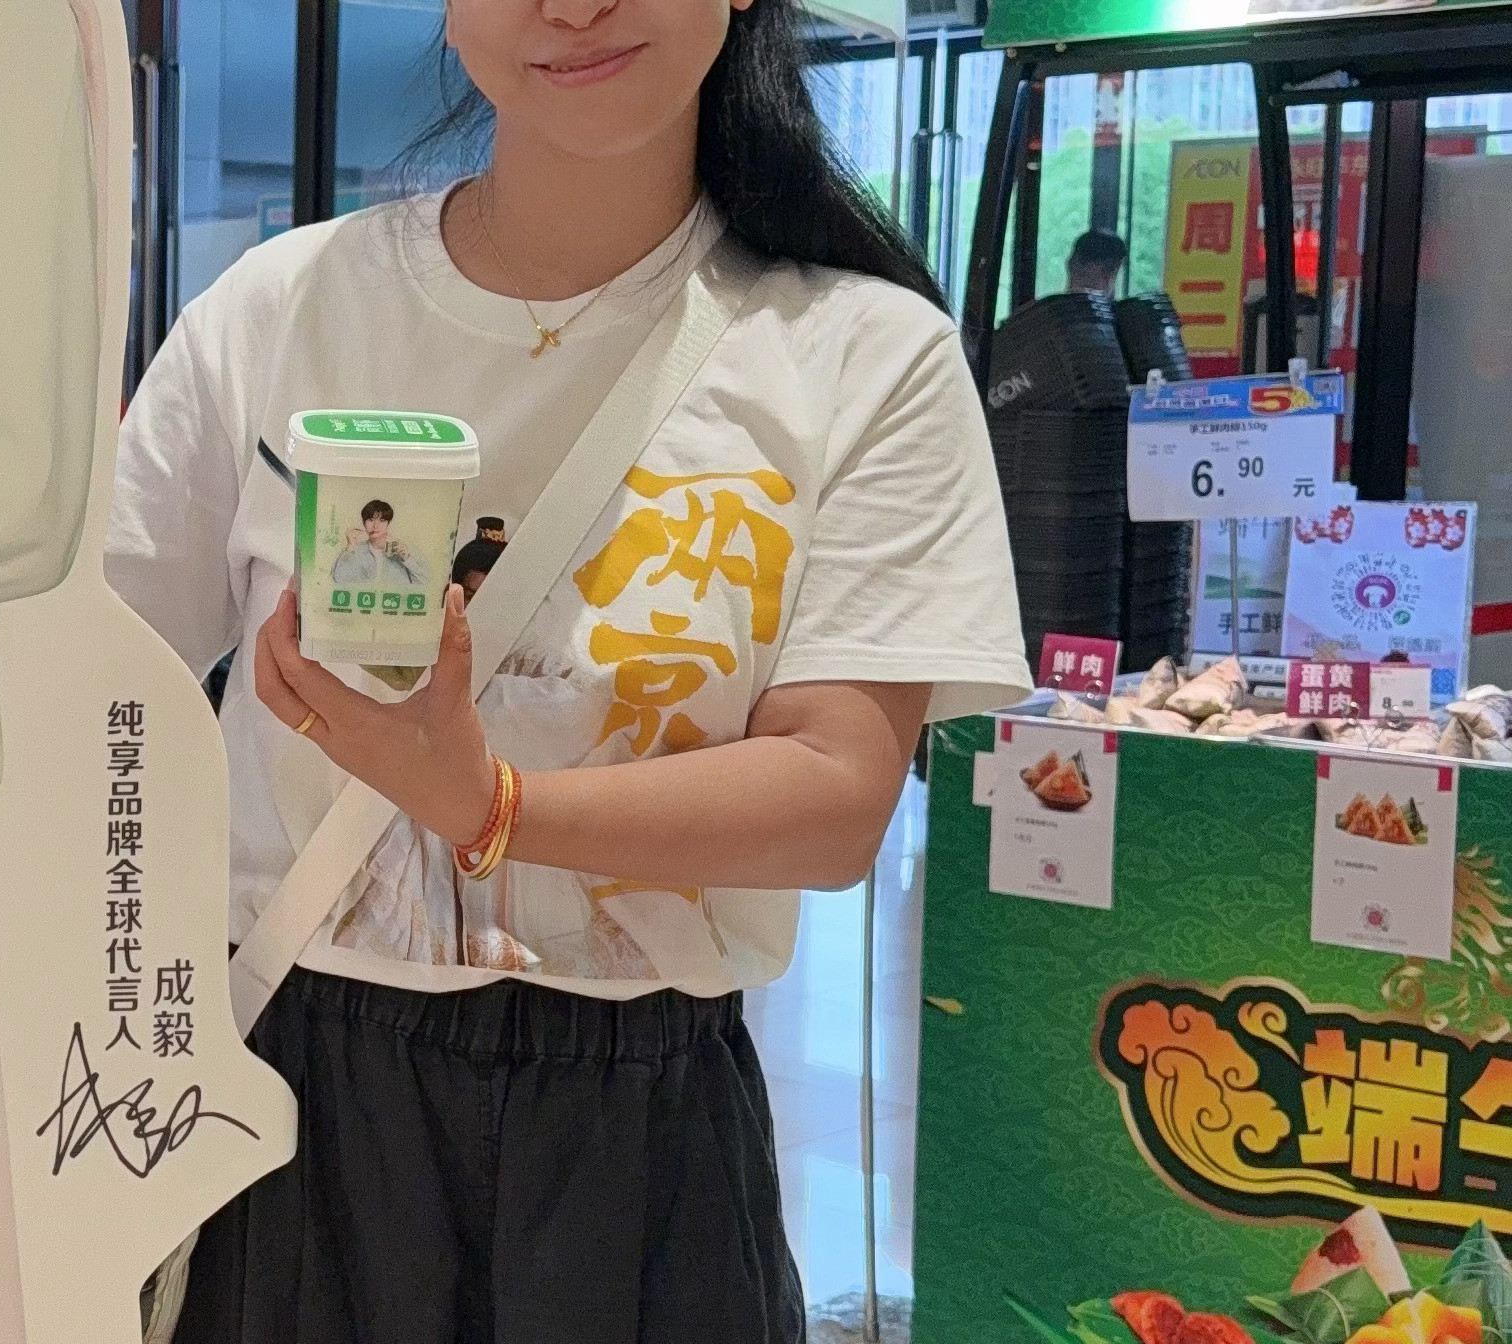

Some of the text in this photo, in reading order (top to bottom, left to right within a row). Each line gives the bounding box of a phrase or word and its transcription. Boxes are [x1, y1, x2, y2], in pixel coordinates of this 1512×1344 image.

[988, 370, 1033, 409] EON
[1292, 477, 1316, 498] 元
[1052, 649, 1105, 678] 鲜肉
[1300, 663, 1354, 689] 蛋黄
[105, 699, 145, 1051] 纯享品牌全球代言人
[152, 958, 195, 1058] 成毅
